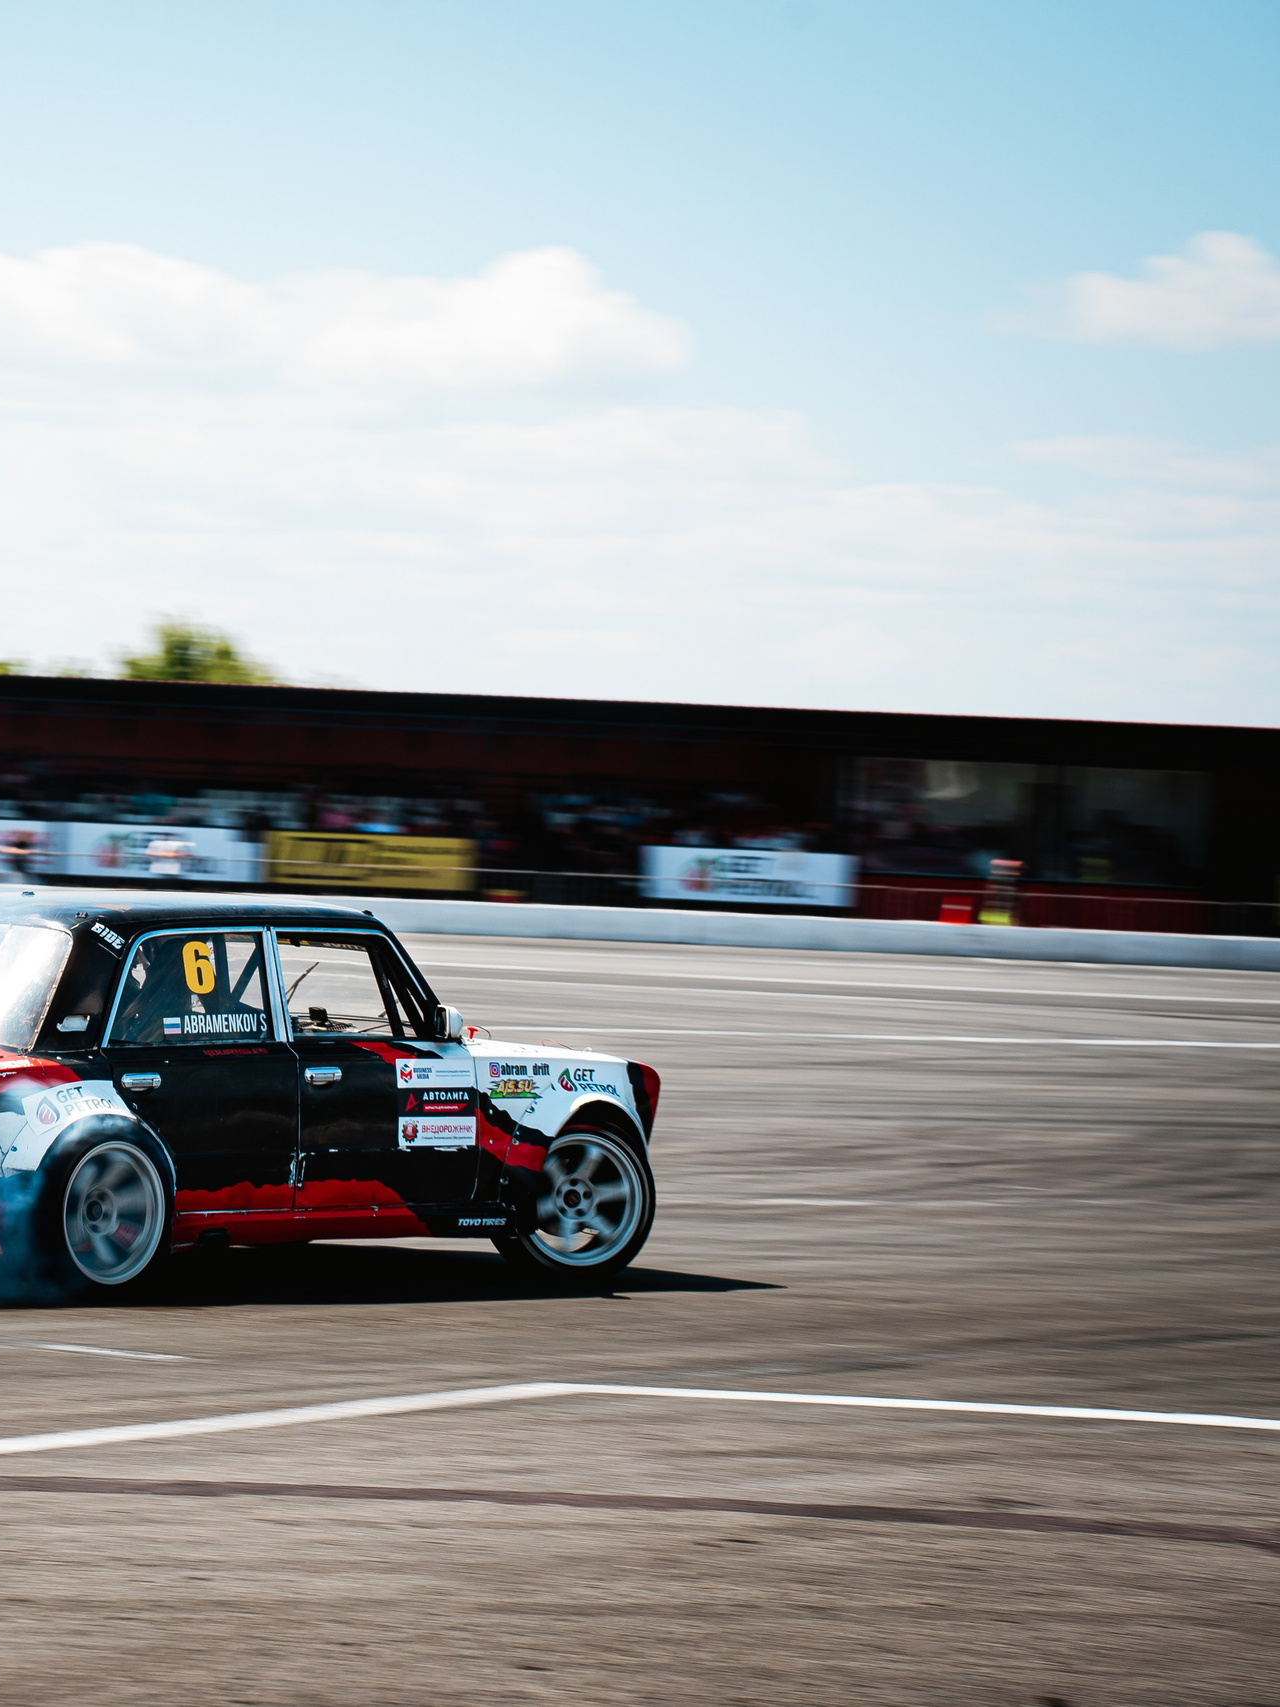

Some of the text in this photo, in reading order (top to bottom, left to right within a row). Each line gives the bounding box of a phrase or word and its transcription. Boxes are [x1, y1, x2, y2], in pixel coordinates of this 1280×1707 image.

[182, 941, 215, 994] 6
[184, 1013, 268, 1034] ABRAMENKOV S
[573, 1068, 595, 1082] GET
[56, 1086, 83, 1103] GET
[422, 1091, 469, 1101] АВТОЛИГА
[578, 1083, 621, 1098] PETROL
[458, 1217, 507, 1226] TOYO TIRES
